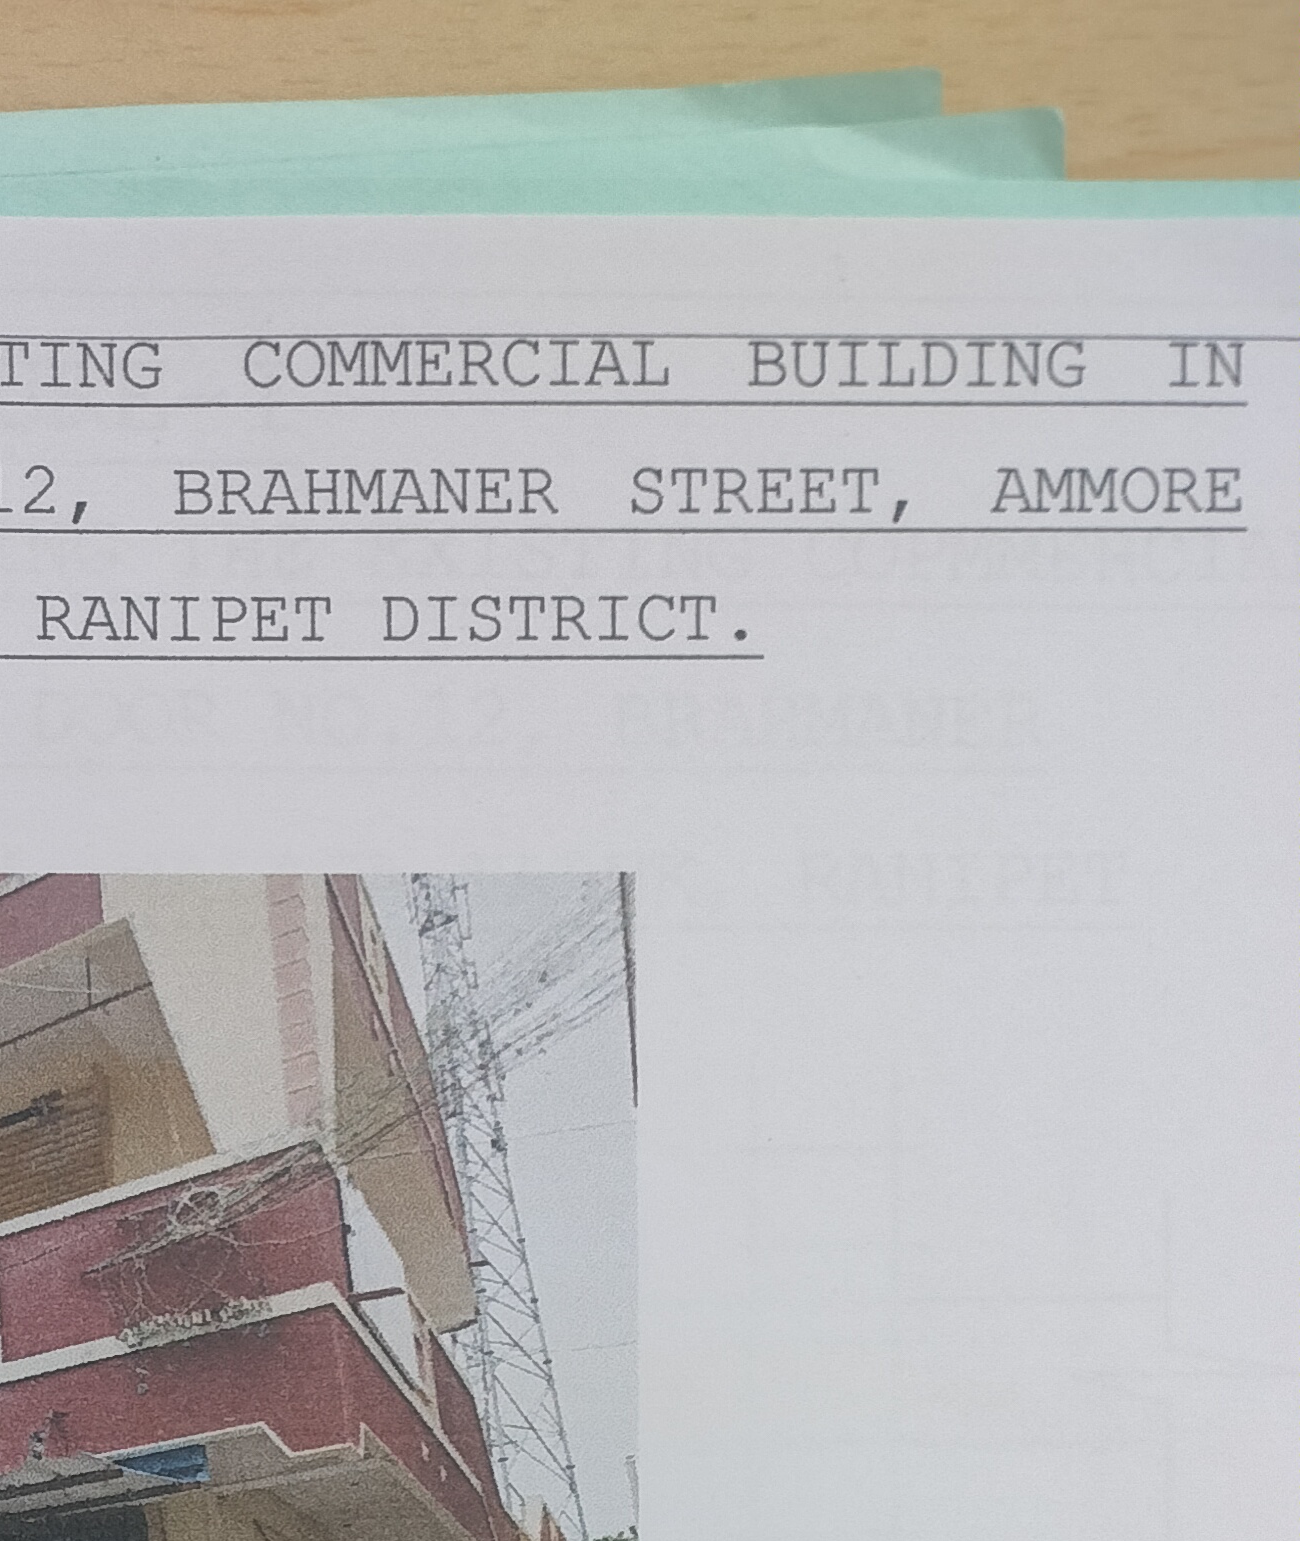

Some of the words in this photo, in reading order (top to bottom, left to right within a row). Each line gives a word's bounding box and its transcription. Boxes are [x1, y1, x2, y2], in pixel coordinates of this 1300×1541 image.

[239, 336, 675, 389] COMMERCIAL
[749, 339, 1087, 390] BUILDING
[1163, 336, 1249, 387] IN
[174, 468, 558, 515] BRAHMANER
[631, 467, 908, 524] STREET,
[991, 467, 1242, 513] AMMORE
[36, 595, 331, 642] RANIPET
[382, 594, 747, 642] DISTRICT.
